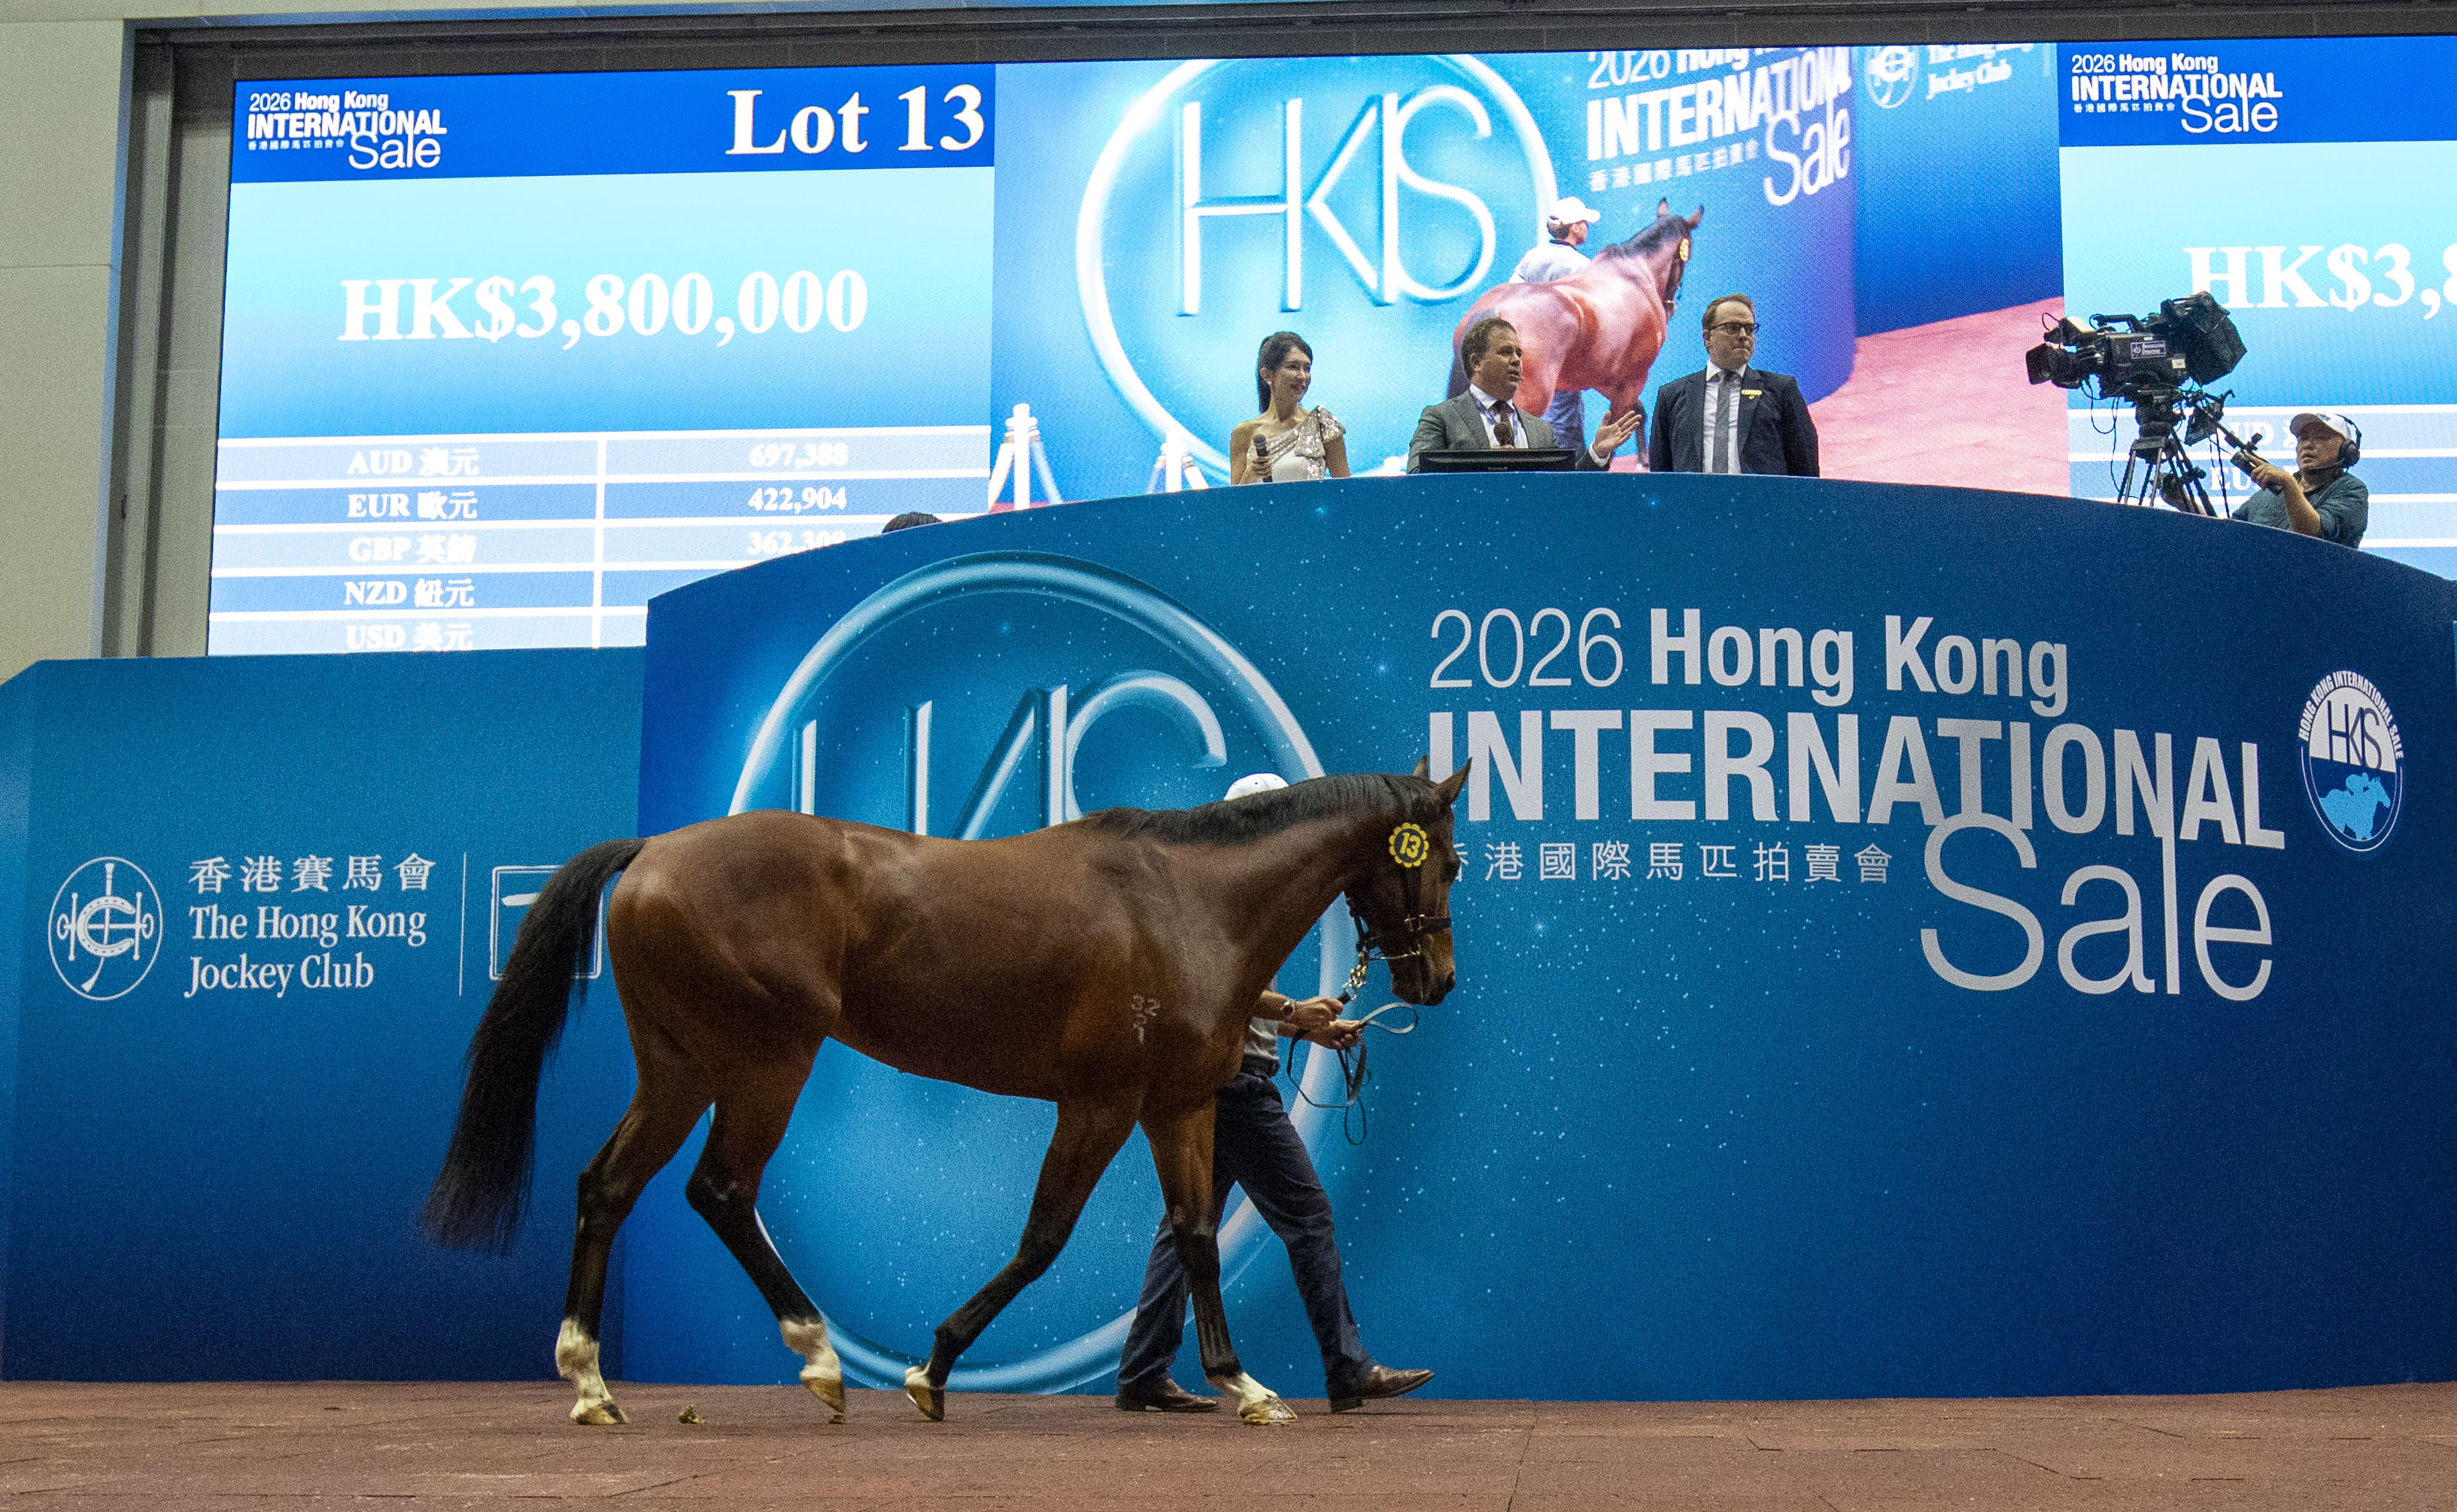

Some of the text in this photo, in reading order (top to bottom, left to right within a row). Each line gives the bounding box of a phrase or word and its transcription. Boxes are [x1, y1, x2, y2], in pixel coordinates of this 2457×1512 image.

[2071, 53, 2219, 74] 2026 Hong Kong
[249, 90, 389, 112] 2026 Hong Kong
[2071, 72, 2283, 101] INTERNATIONAL
[248, 109, 448, 138] INTERNATIONAL
[725, 83, 986, 156] Lot 13
[2181, 90, 2279, 133] Sale
[348, 129, 442, 170] Sale
[1763, 104, 1851, 206] Sale
[337, 268, 868, 351] HK$3,800,000
[347, 450, 413, 475] AUD
[348, 493, 411, 518] EUR
[748, 486, 847, 515] 422,904
[348, 536, 412, 562] GBP
[344, 581, 408, 605] NZD
[346, 624, 406, 650] USD
[1431, 607, 2070, 718] 2026 Hong Kong
[2298, 670, 2404, 760] HONG KONG INTERNATIONAL SALE
[1428, 710, 2286, 850] INTERNATIONAL
[1399, 831, 1421, 859] 13
[187, 852, 436, 894] 香港賽馬會
[1920, 801, 2275, 1001] Sale
[188, 904, 427, 947] The Hong Kong
[184, 953, 375, 999] Jockey Club
